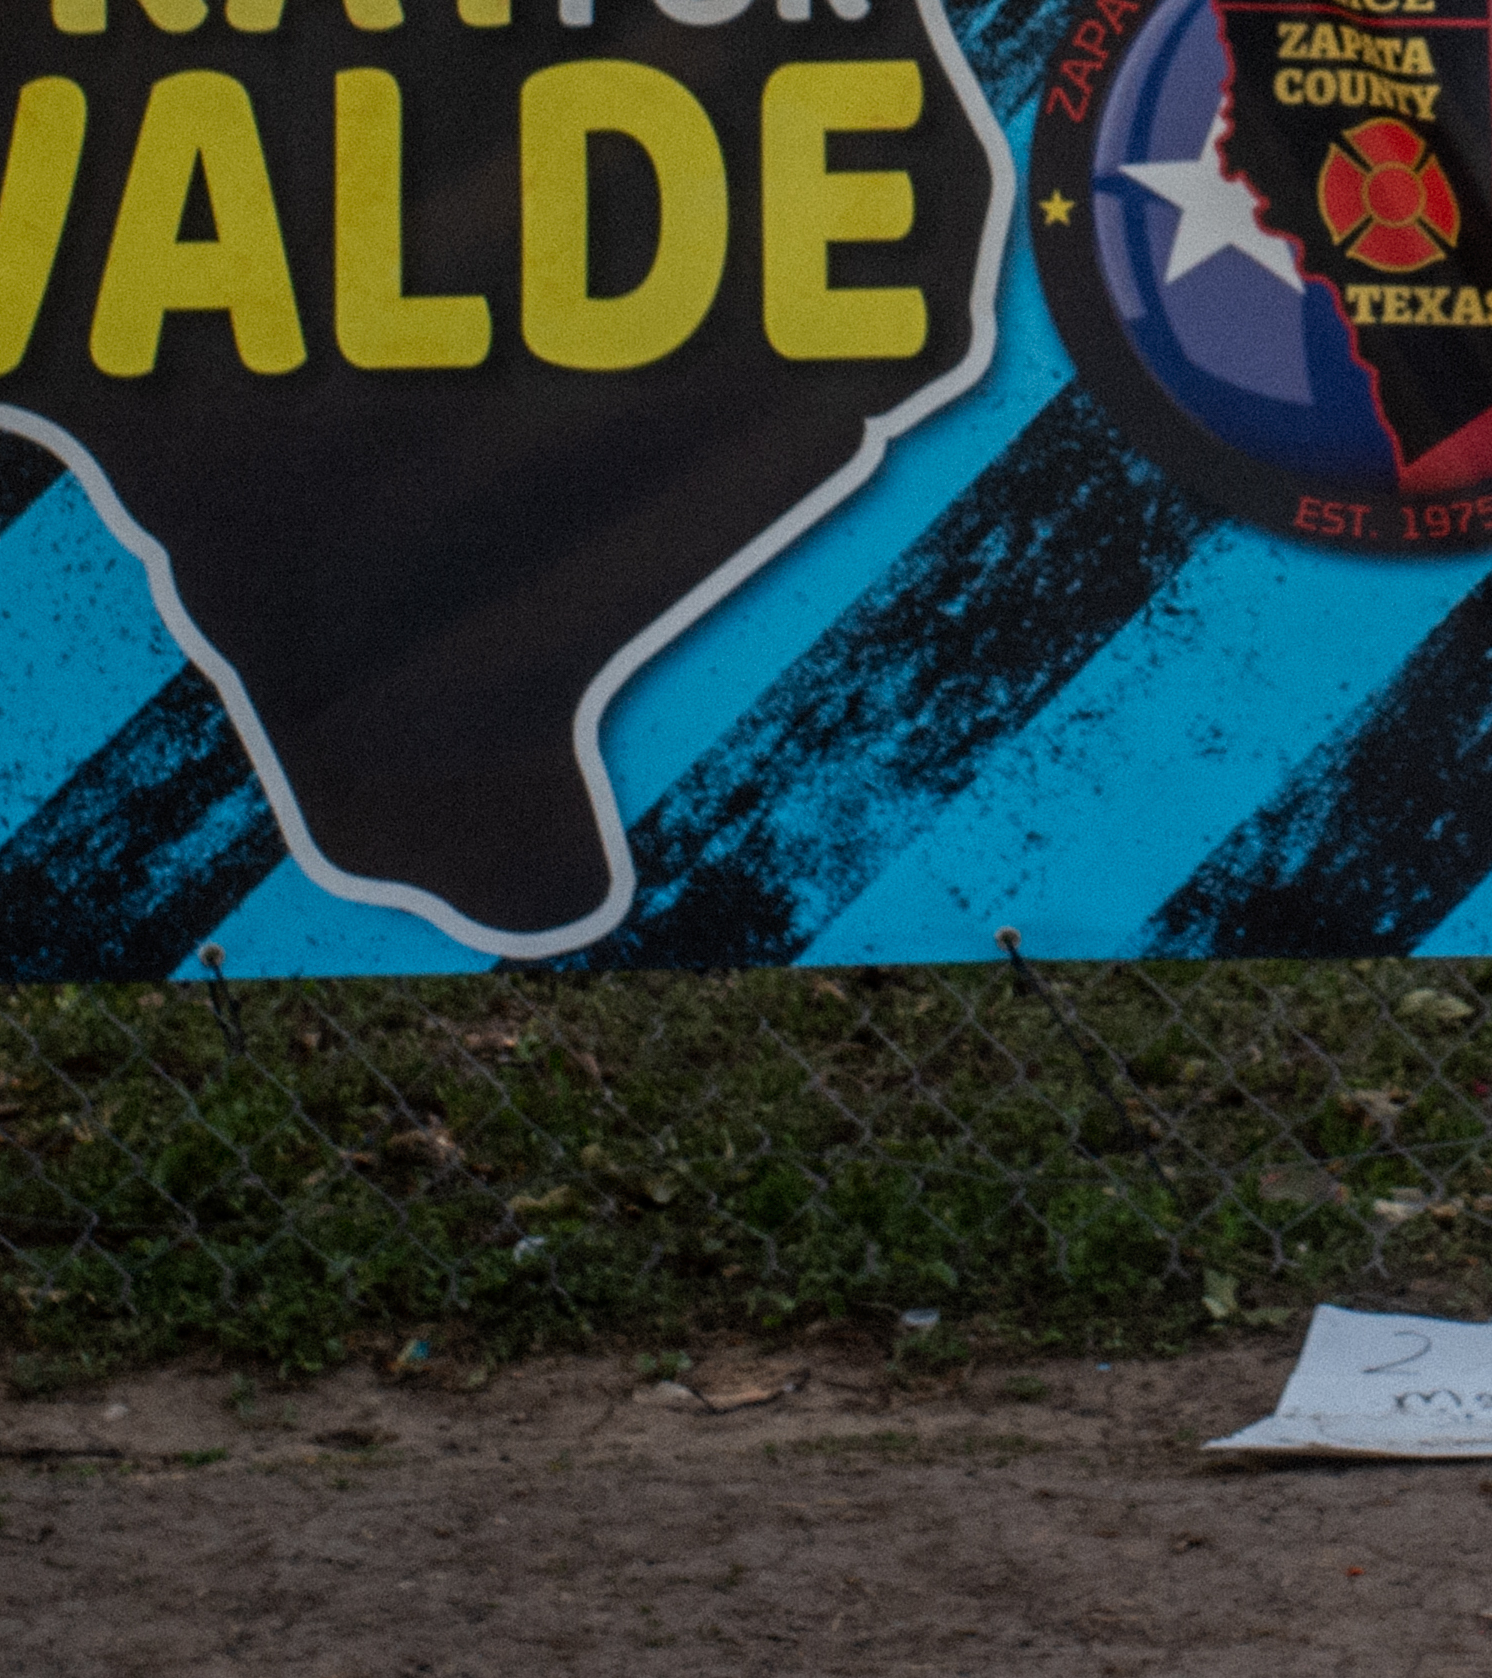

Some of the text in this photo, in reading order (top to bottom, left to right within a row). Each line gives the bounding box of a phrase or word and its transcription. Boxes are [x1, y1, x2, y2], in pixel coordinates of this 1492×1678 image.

[1277, 24, 1434, 75] ZAPATA
[1273, 68, 1439, 120] COUNTY
[1293, 496, 1378, 538] EST.
[1363, 1330, 1432, 1374] 2
